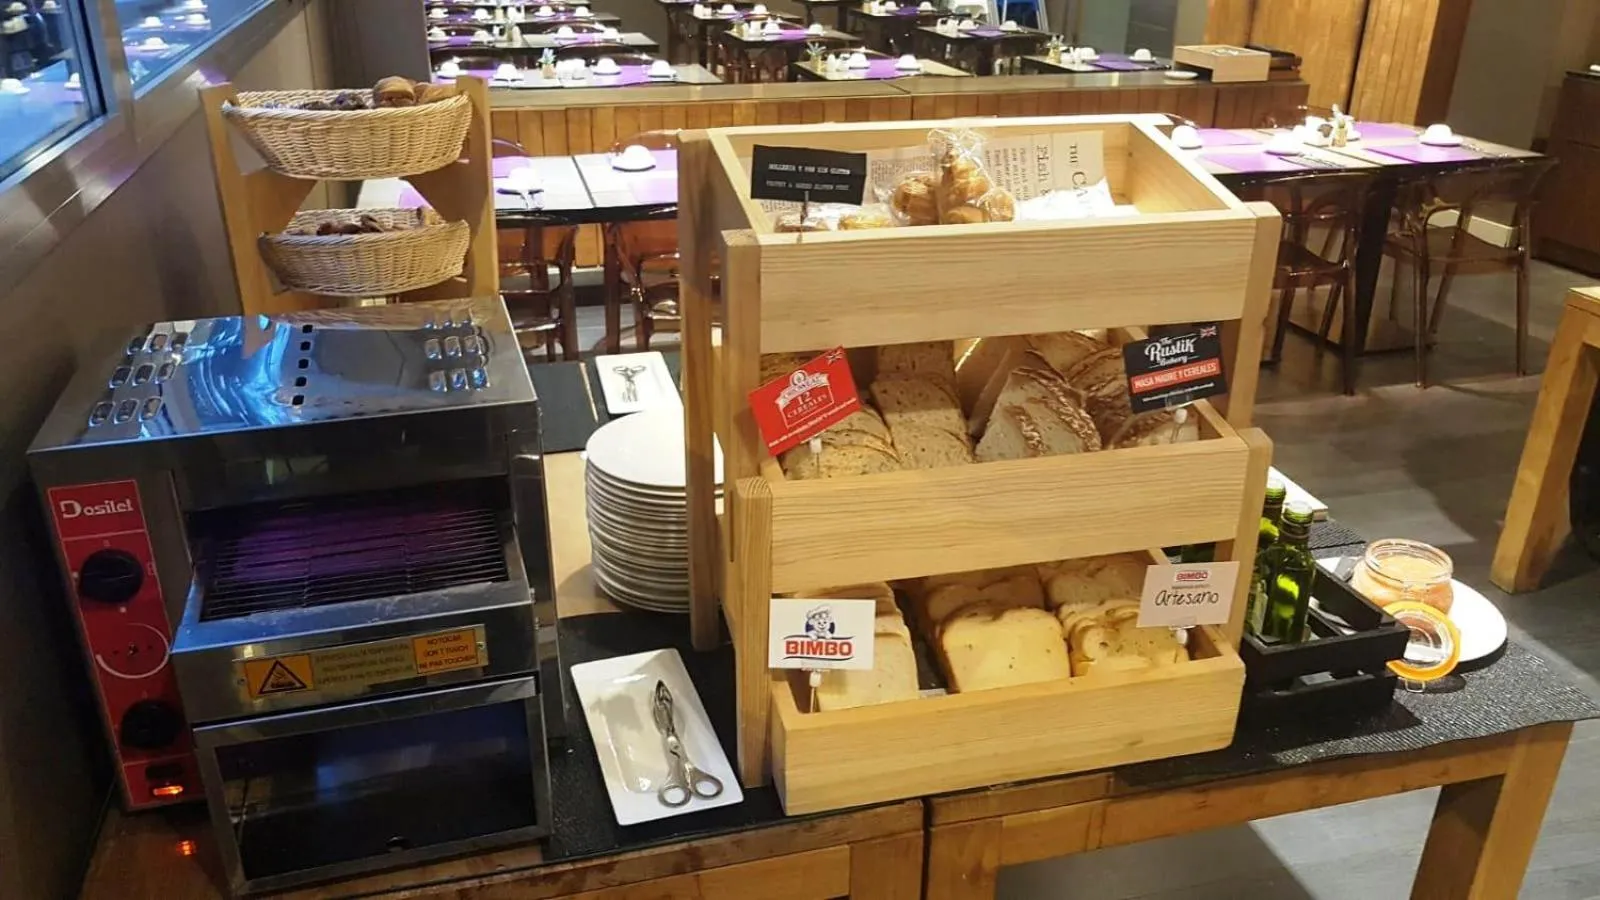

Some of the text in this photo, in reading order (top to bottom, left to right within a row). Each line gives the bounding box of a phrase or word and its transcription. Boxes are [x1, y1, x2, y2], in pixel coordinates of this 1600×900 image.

[1134, 362, 1217, 389] MASA MADRE Y CEREALES
[59, 498, 134, 519] Dosilet
[1176, 571, 1208, 580] BIMBO
[784, 640, 852, 656] BIMBO
